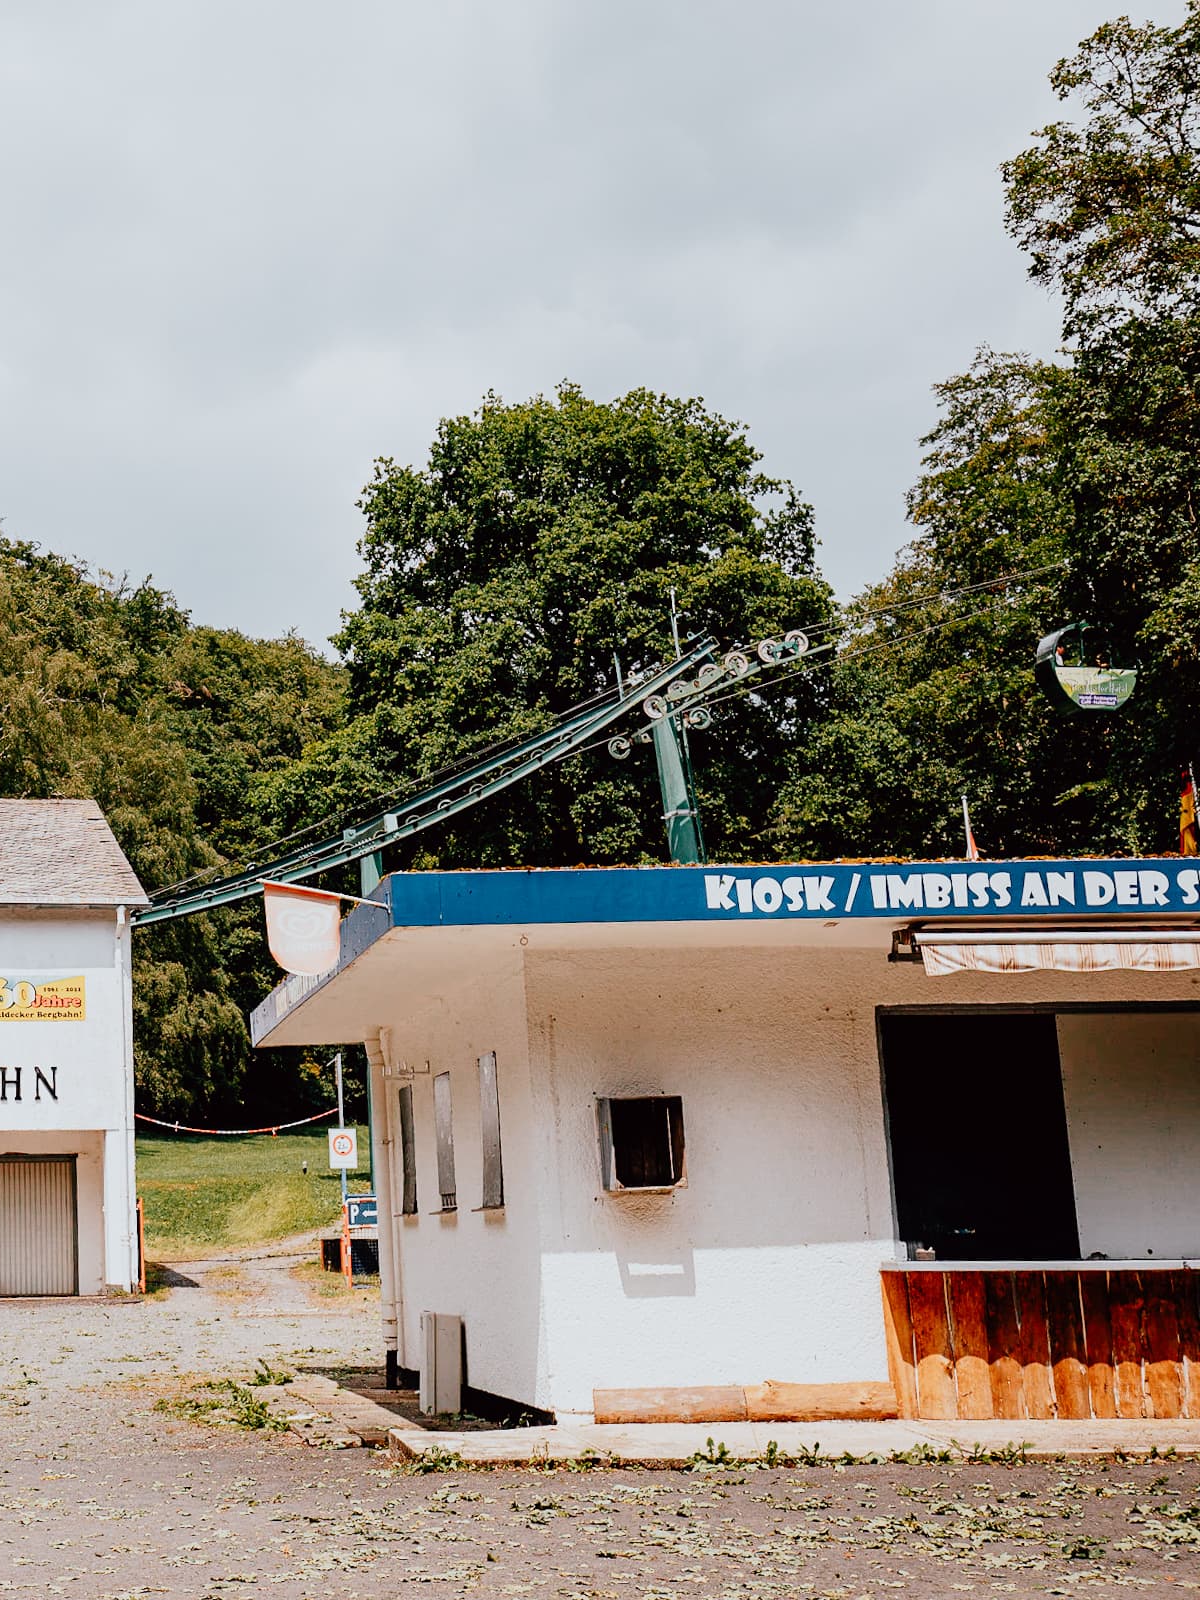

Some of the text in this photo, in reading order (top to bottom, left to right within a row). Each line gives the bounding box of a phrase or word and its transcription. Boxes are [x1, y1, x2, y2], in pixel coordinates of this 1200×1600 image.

[705, 869, 1200, 912] KIOSK / IMBISS AN DER S
[33, 995, 82, 1008] Jahre
[37, 1011, 82, 1020] Bergbahn!
[350, 1204, 360, 1224] P
